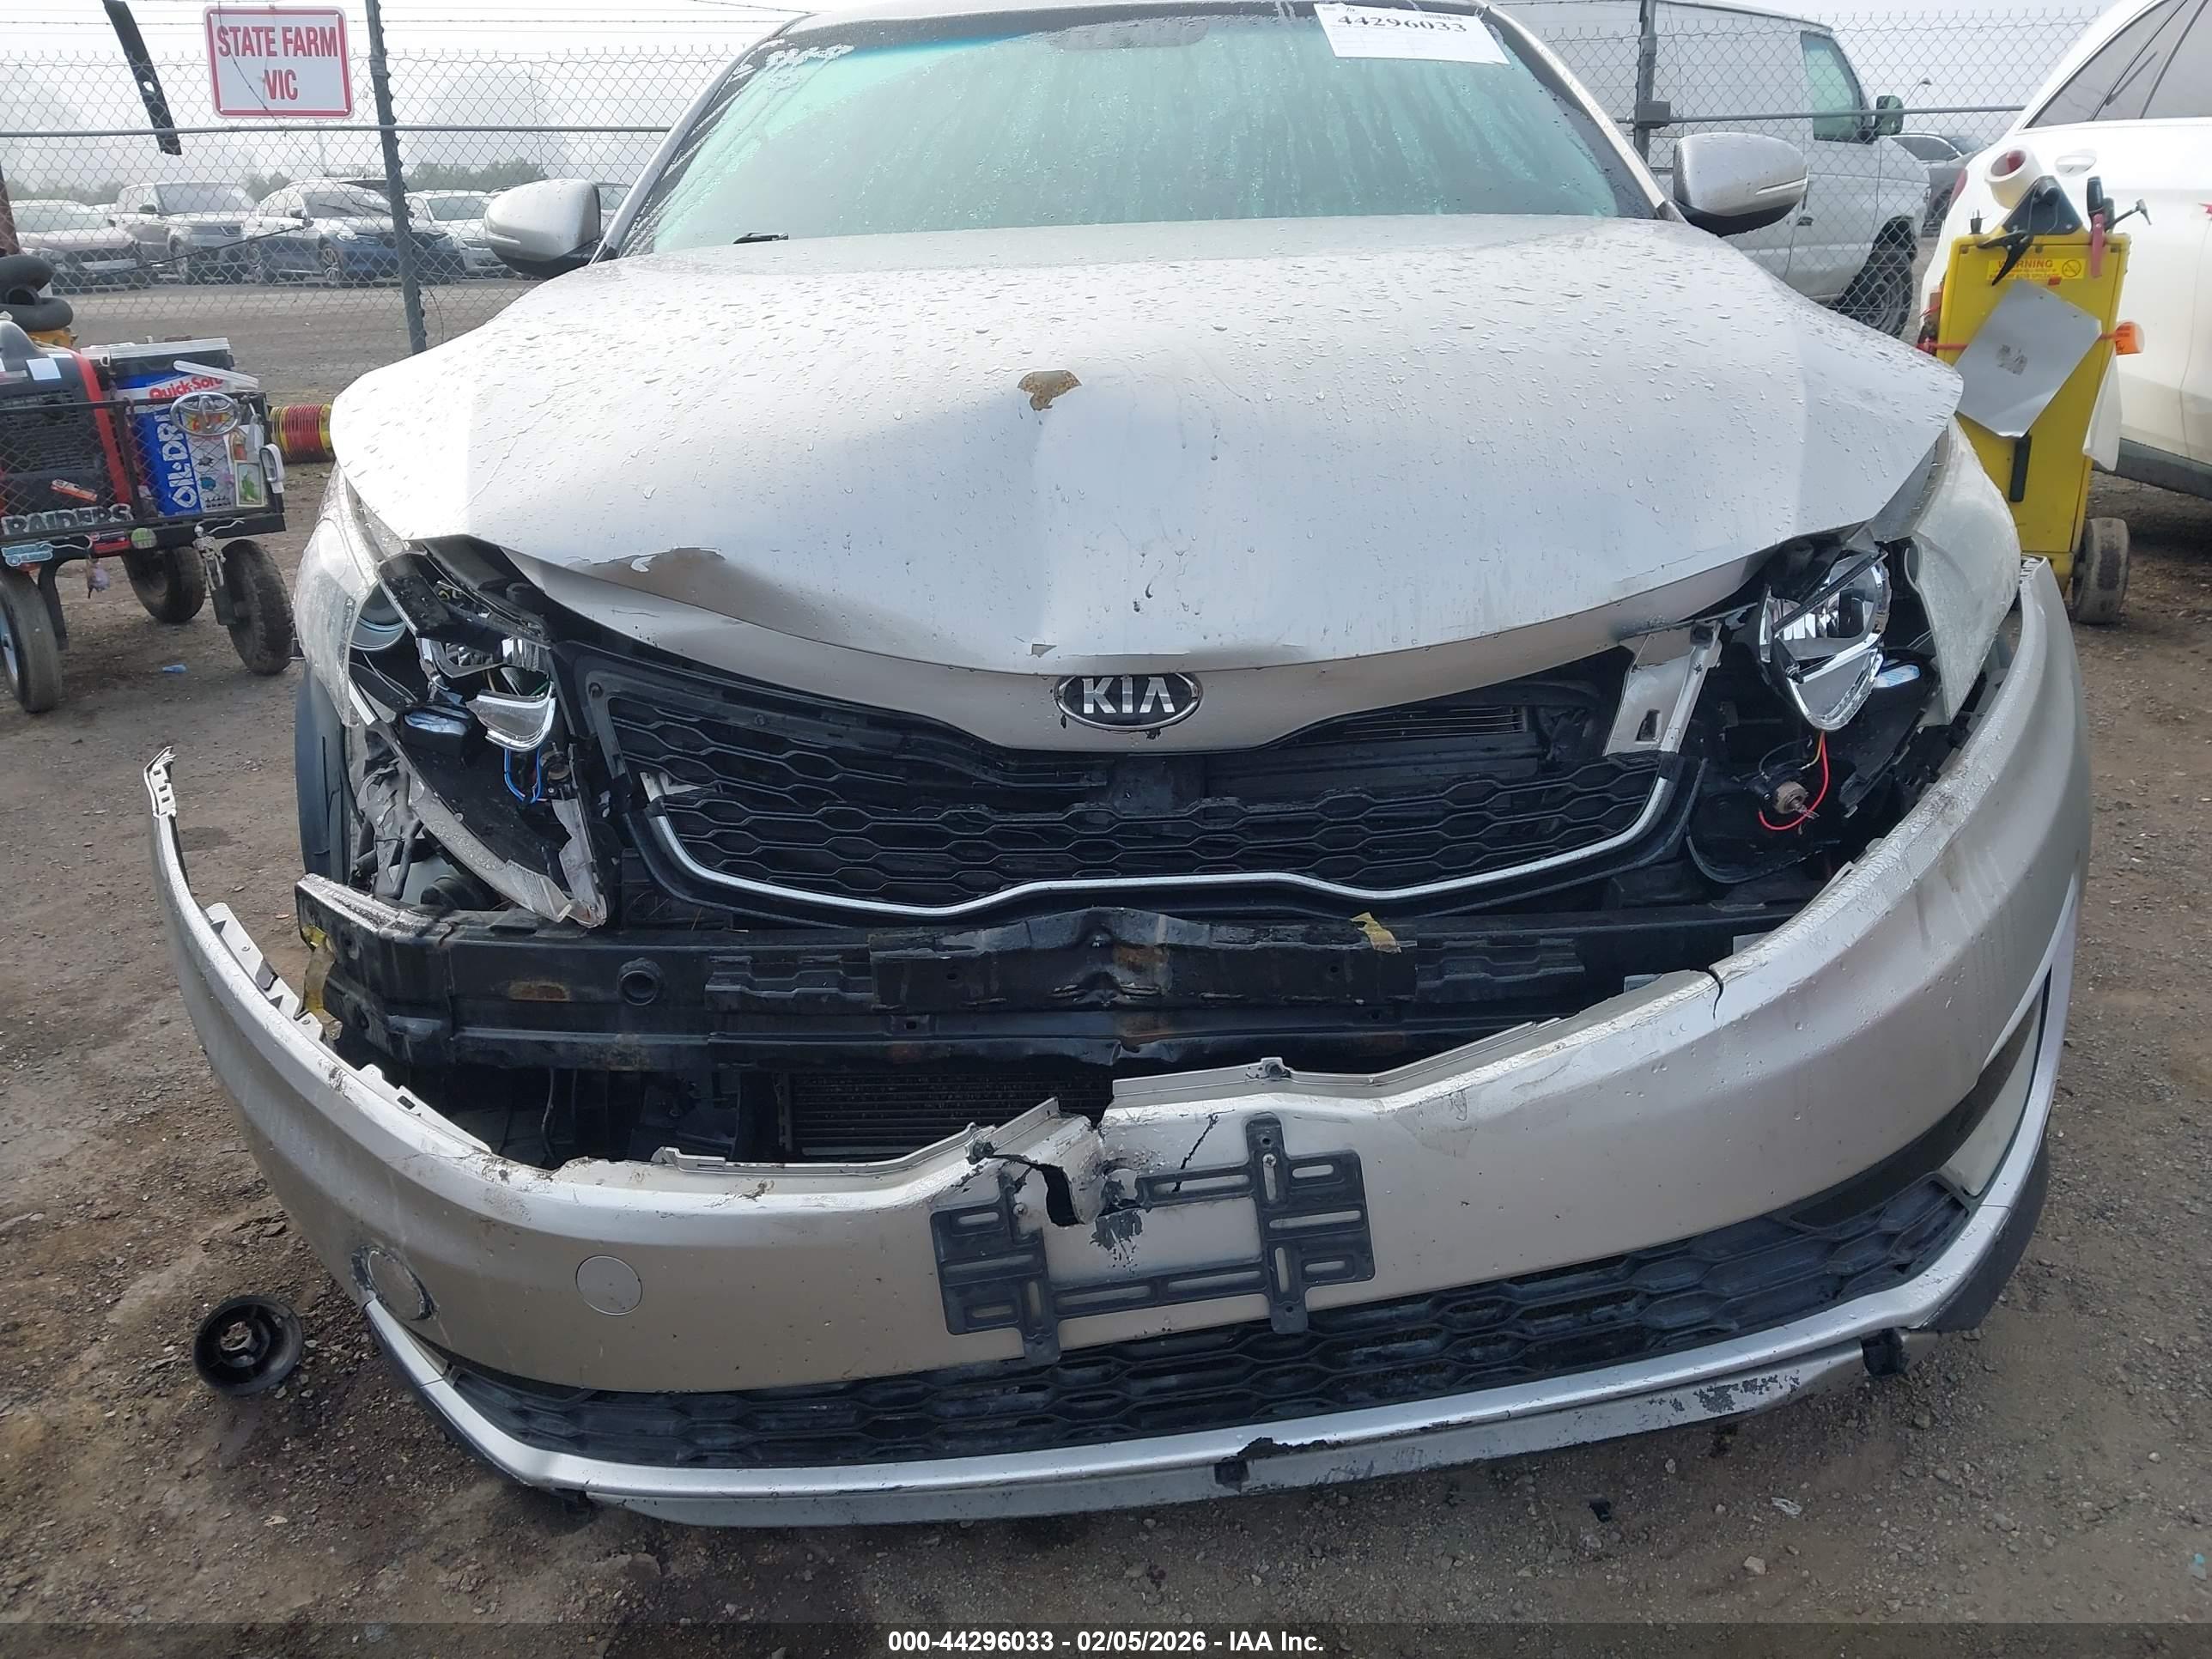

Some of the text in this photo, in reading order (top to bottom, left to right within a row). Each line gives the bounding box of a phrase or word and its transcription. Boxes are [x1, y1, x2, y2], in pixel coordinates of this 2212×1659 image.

[1338, 15, 1468, 33] 44296033
[217, 26, 337, 57] STATE FARM
[264, 70, 298, 100] VIC
[1998, 259, 2054, 269] WRNING
[3, 504, 133, 534] RAIDERS
[1082, 677, 1175, 714] KIA
